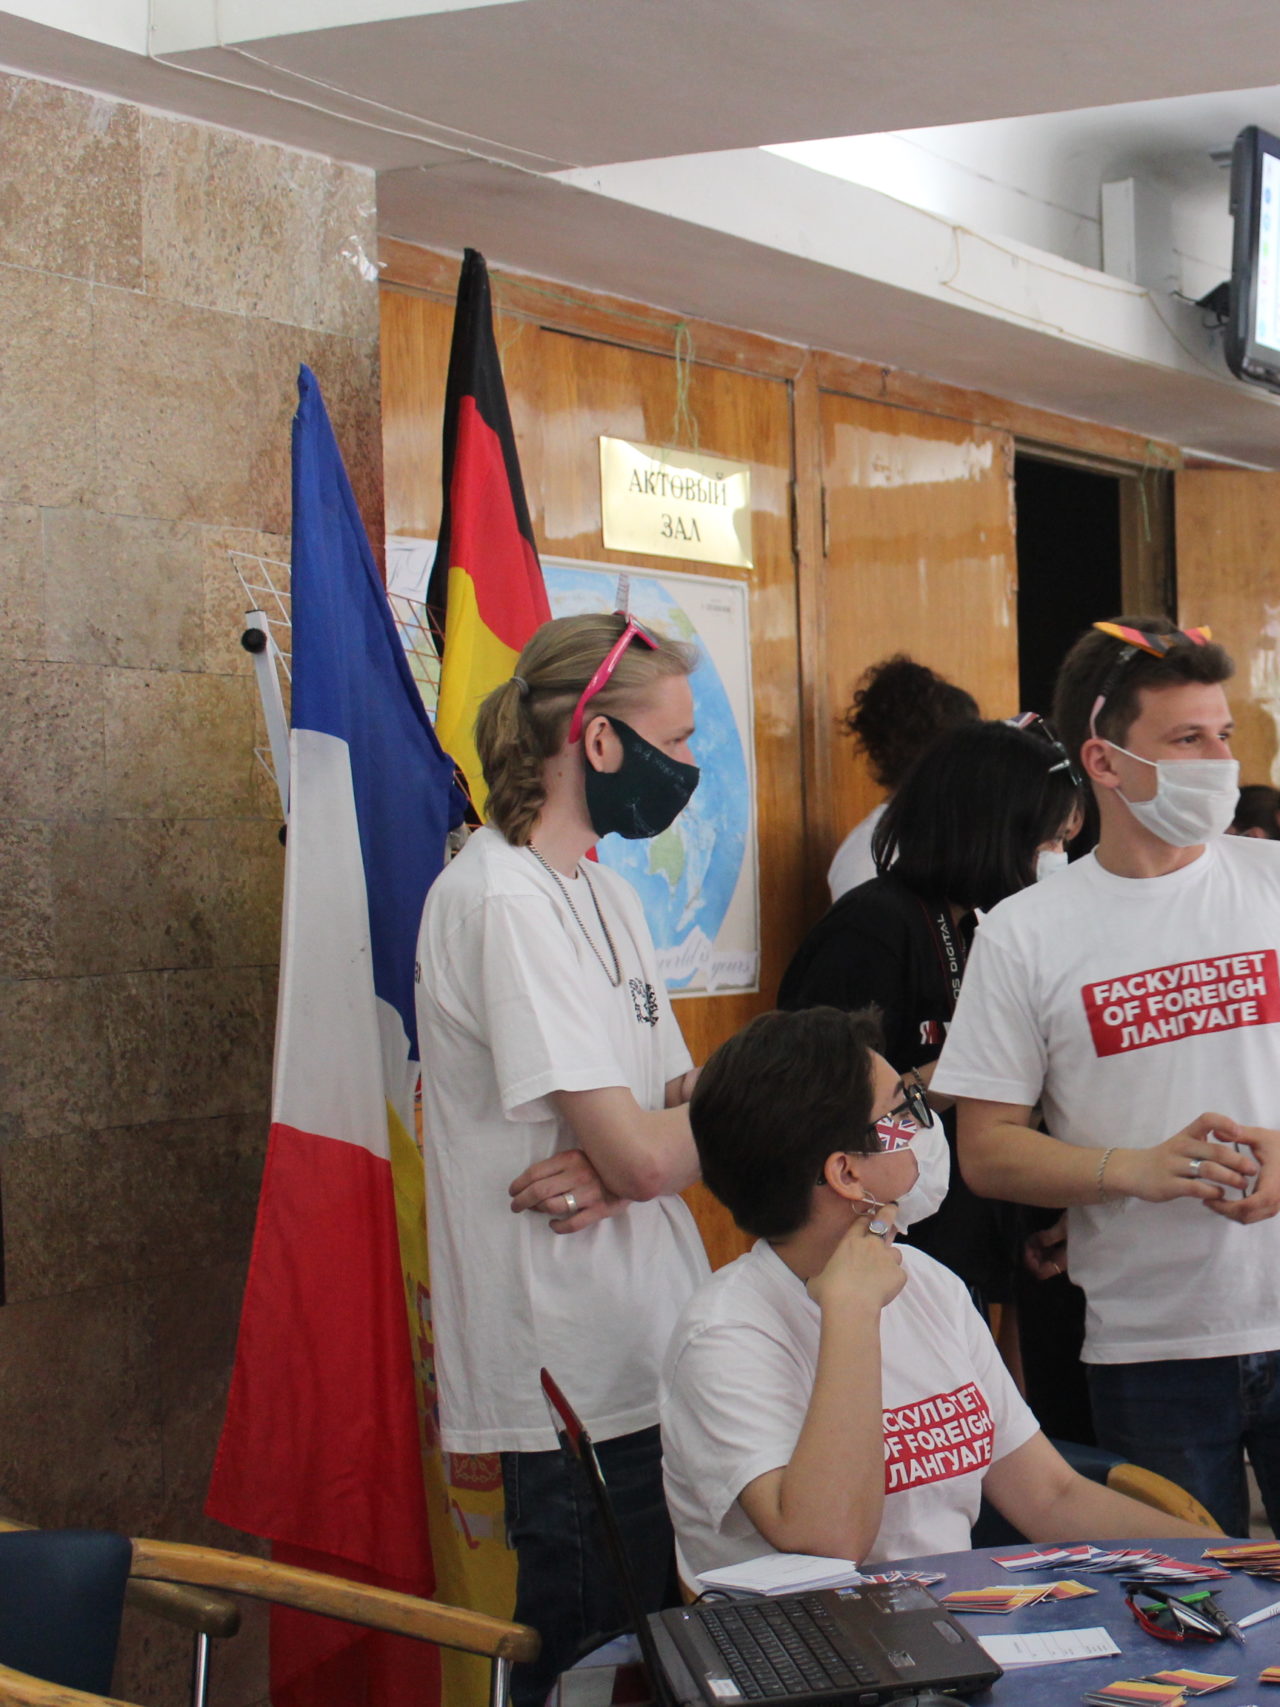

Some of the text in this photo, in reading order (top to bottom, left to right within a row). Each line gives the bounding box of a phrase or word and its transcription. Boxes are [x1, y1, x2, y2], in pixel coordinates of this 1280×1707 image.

[629, 468, 727, 506] АКТОВЫЙ
[660, 513, 701, 542] ЗАЛ
[937, 913, 958, 972] DIGITAL
[1102, 1000, 1142, 1027] OF
[1120, 1000, 1259, 1049] ЛАНГУАГЕ
[888, 1436, 992, 1488] ЛАНГУАГЕ
